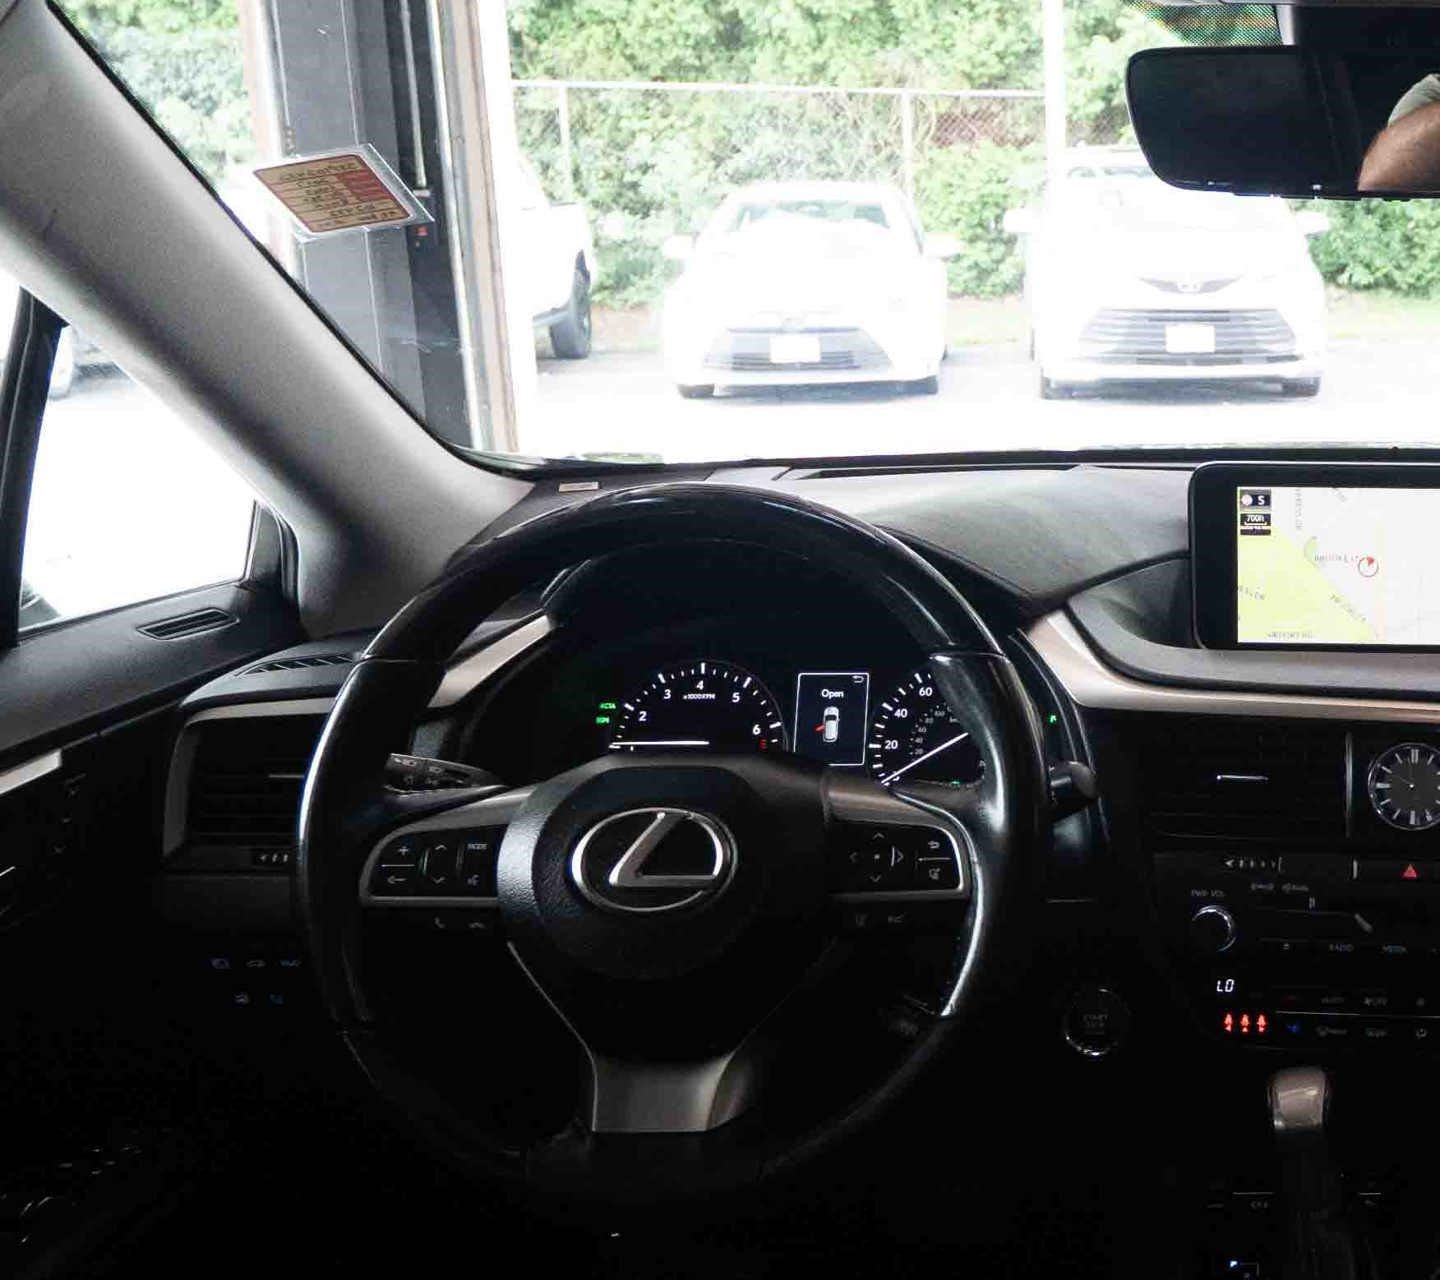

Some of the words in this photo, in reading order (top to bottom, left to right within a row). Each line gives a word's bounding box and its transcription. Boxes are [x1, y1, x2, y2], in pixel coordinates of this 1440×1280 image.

[1257, 495, 1265, 506] S
[696, 680, 704, 690] 4
[663, 689, 671, 700] 3
[732, 692, 740, 703] 5
[821, 689, 844, 699] Open
[918, 687, 933, 697] 60
[638, 711, 648, 722] 2
[894, 708, 908, 718] 40
[752, 724, 761, 735] 6
[884, 739, 898, 750] 20
